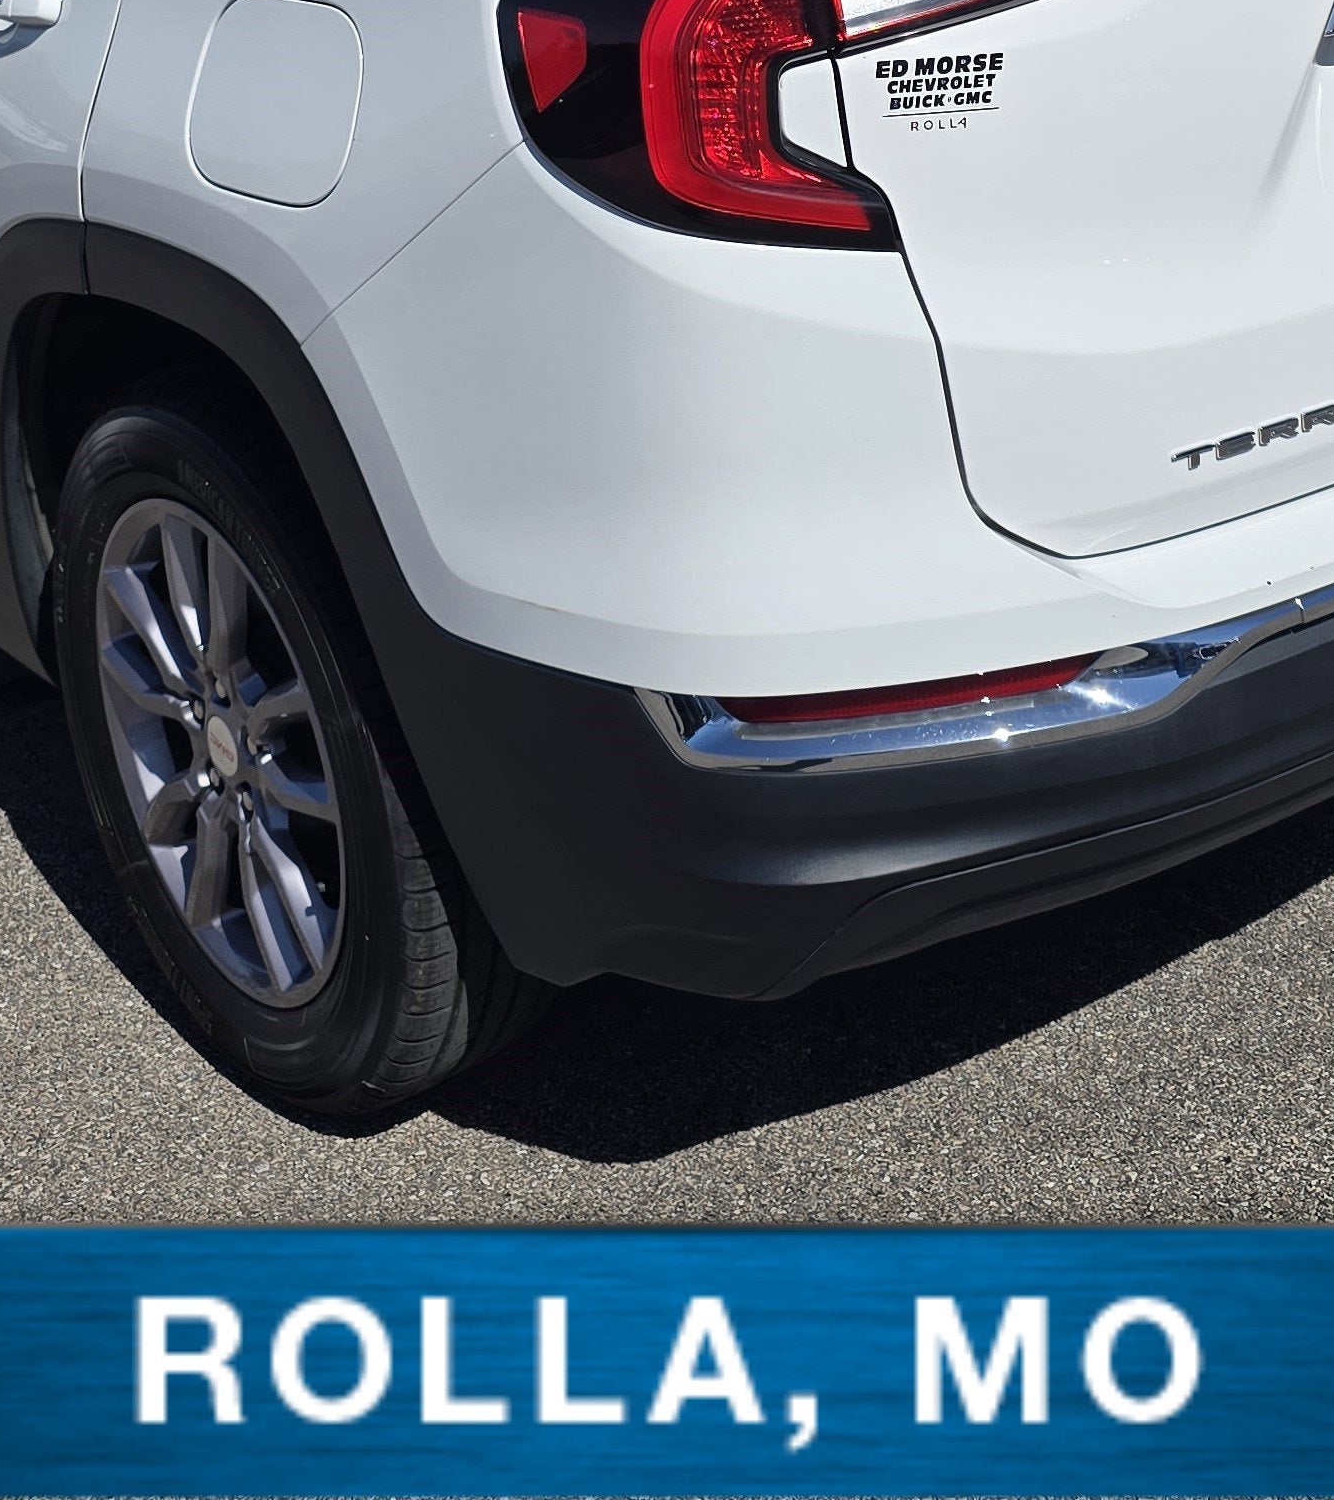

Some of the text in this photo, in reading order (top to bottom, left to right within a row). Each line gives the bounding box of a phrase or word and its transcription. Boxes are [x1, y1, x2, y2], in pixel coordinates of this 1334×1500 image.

[875, 52, 1004, 79] ED MORSE
[887, 73, 997, 94] CHEVROLET
[910, 117, 968, 131] ROLLA
